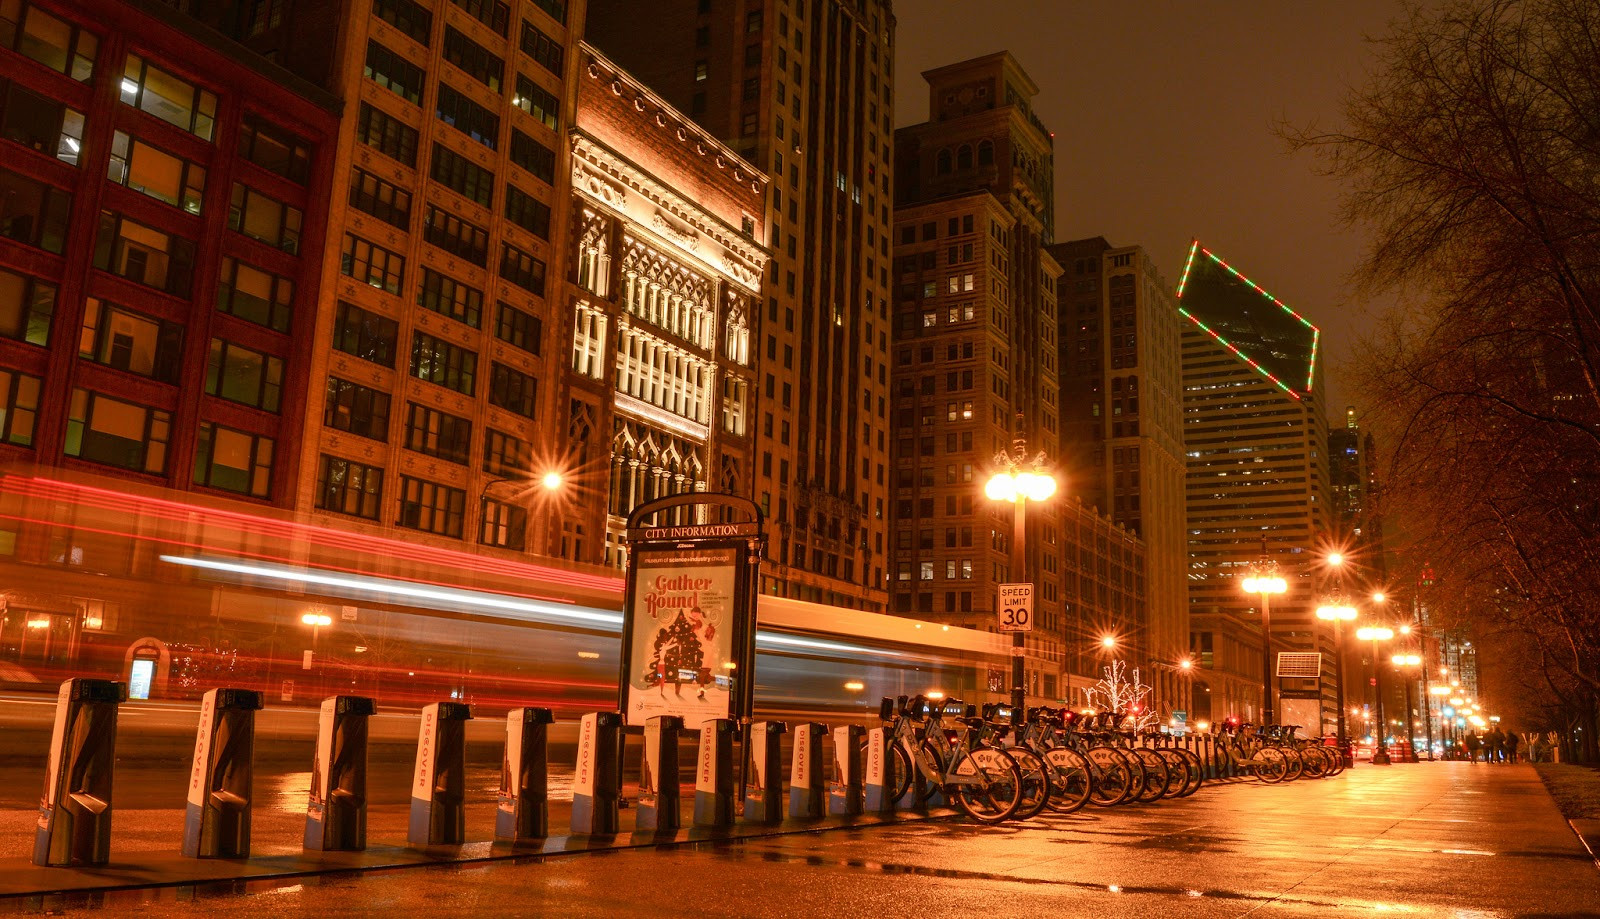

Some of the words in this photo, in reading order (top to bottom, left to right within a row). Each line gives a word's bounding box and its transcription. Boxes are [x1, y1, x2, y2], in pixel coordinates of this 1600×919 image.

[645, 528, 668, 539] CITY
[671, 525, 739, 538] INFORMATION
[655, 574, 713, 596] Gather
[1001, 588, 1031, 597] SPEED
[644, 591, 698, 619] Round
[1004, 597, 1027, 606] LIMIT
[1002, 608, 1029, 625] 30
